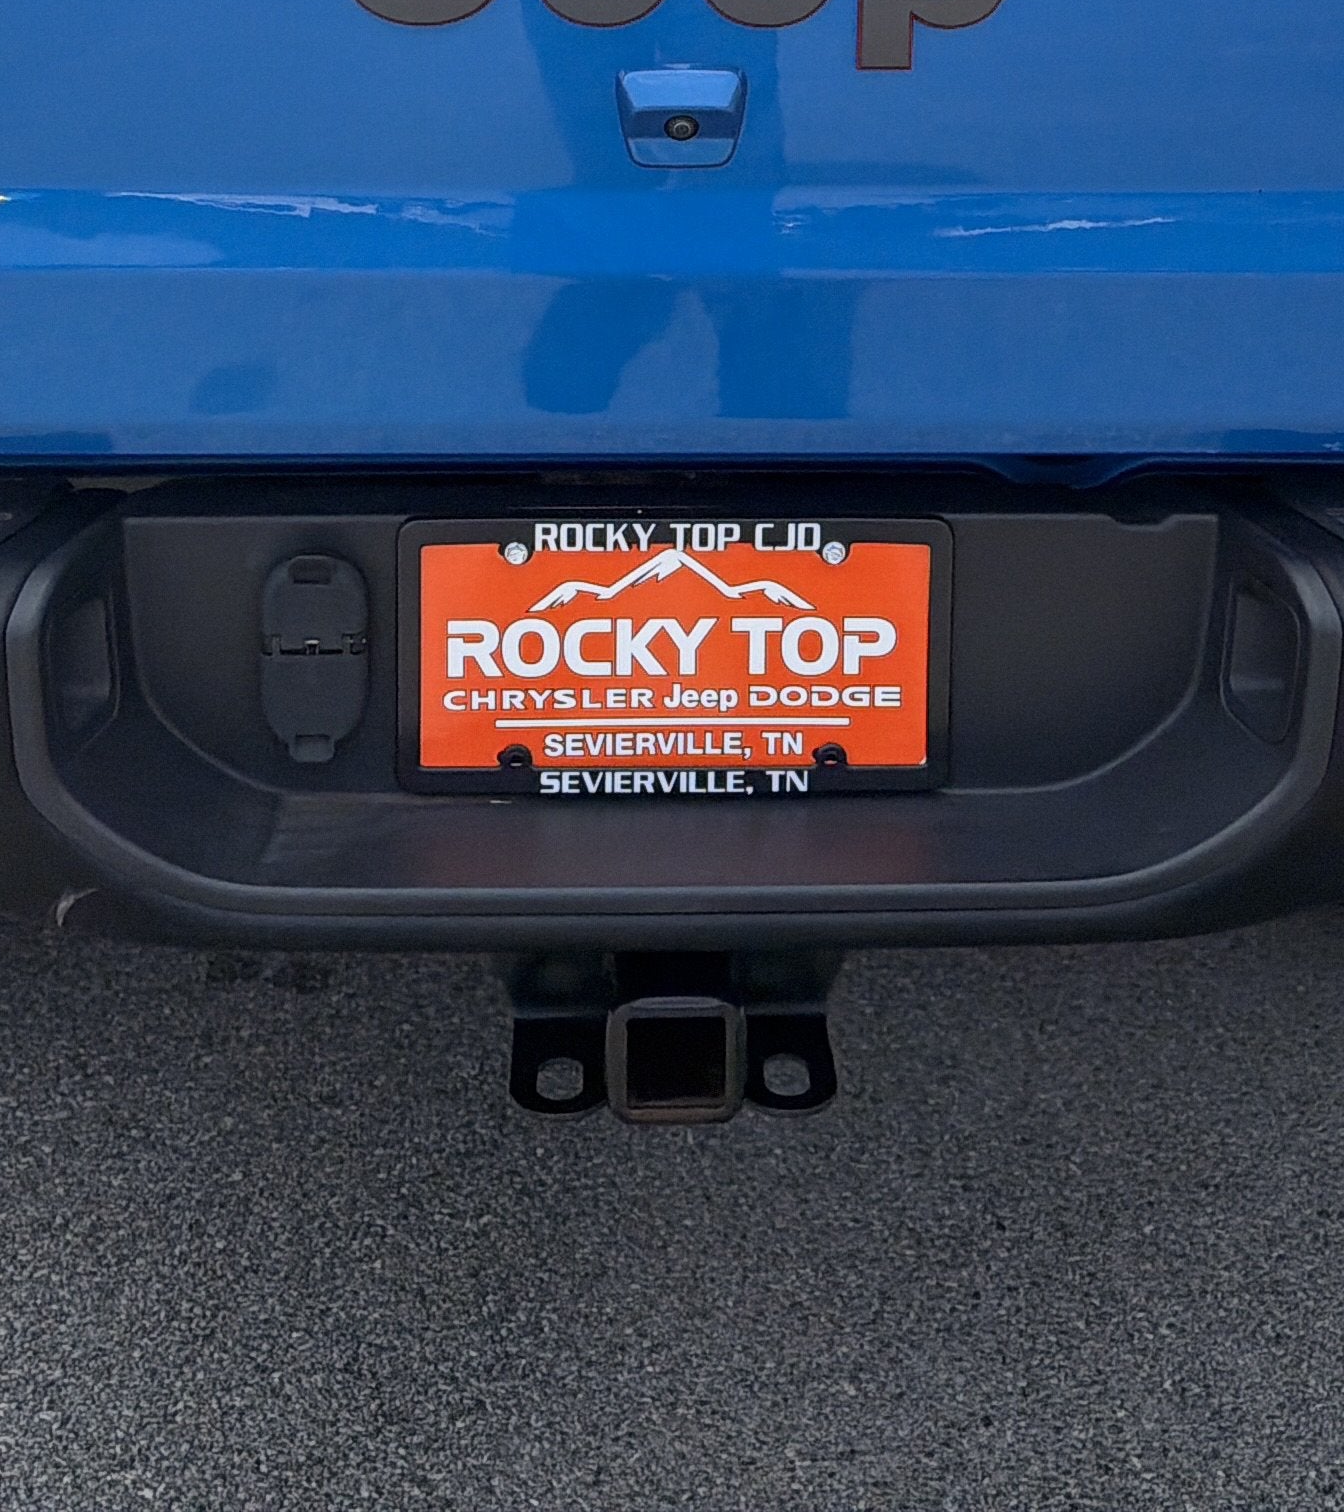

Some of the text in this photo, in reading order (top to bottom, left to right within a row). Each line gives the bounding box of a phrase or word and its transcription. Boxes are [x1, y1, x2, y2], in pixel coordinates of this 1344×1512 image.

[534, 522, 822, 553] ROCKY TOP CJD
[445, 616, 898, 679] ROCKY TOP
[442, 683, 902, 713] CHRYSLER Jeep DODGE
[543, 731, 804, 761] SEVIERVILLE, TN
[539, 770, 809, 796] SEVIERVILLE, TN
